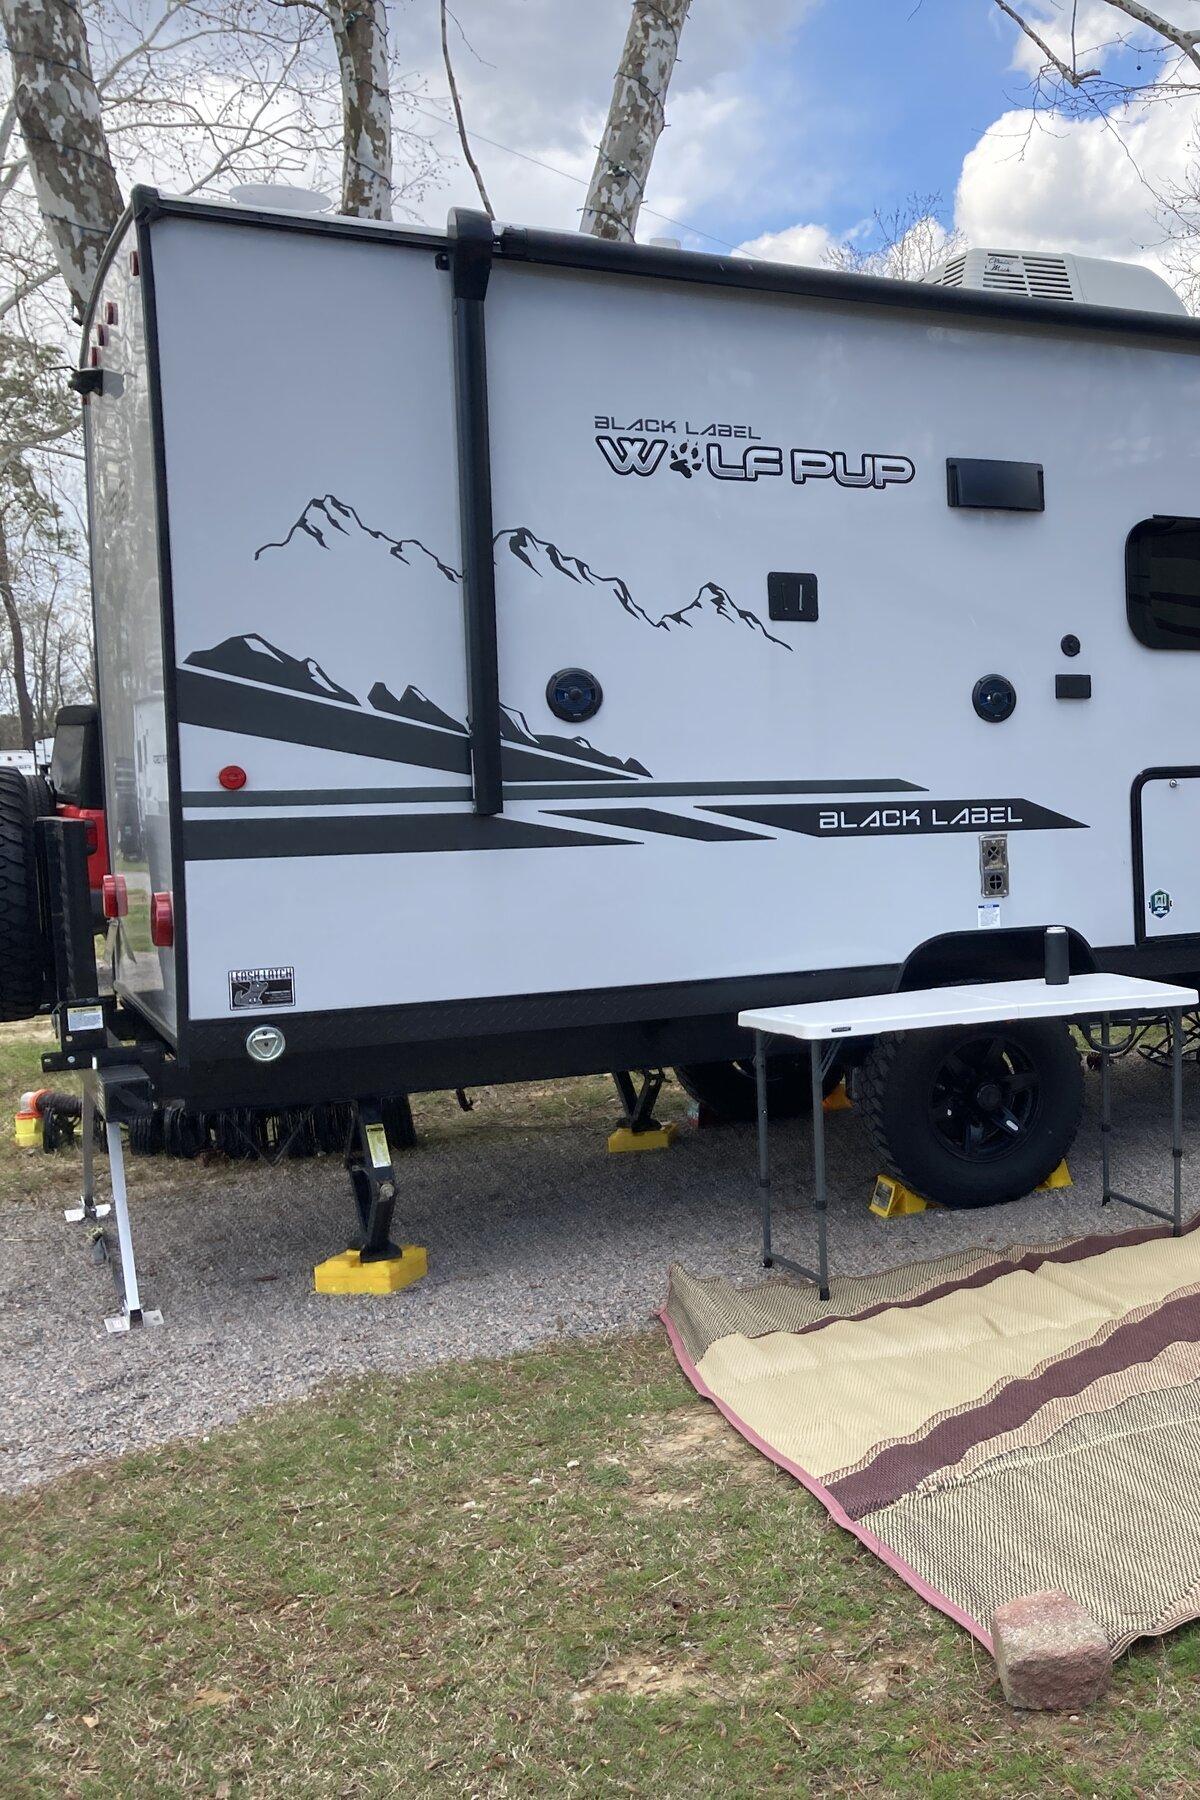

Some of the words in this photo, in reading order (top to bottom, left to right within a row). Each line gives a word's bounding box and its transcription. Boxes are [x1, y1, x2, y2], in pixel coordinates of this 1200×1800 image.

[594, 415, 677, 434] BLACK
[685, 421, 762, 440] LABEL
[790, 448, 916, 490] PUP
[818, 808, 921, 830] BLACK
[932, 806, 1023, 826] LABEL
[230, 969, 260, 981] LEASH
[263, 967, 292, 980] LATCH
